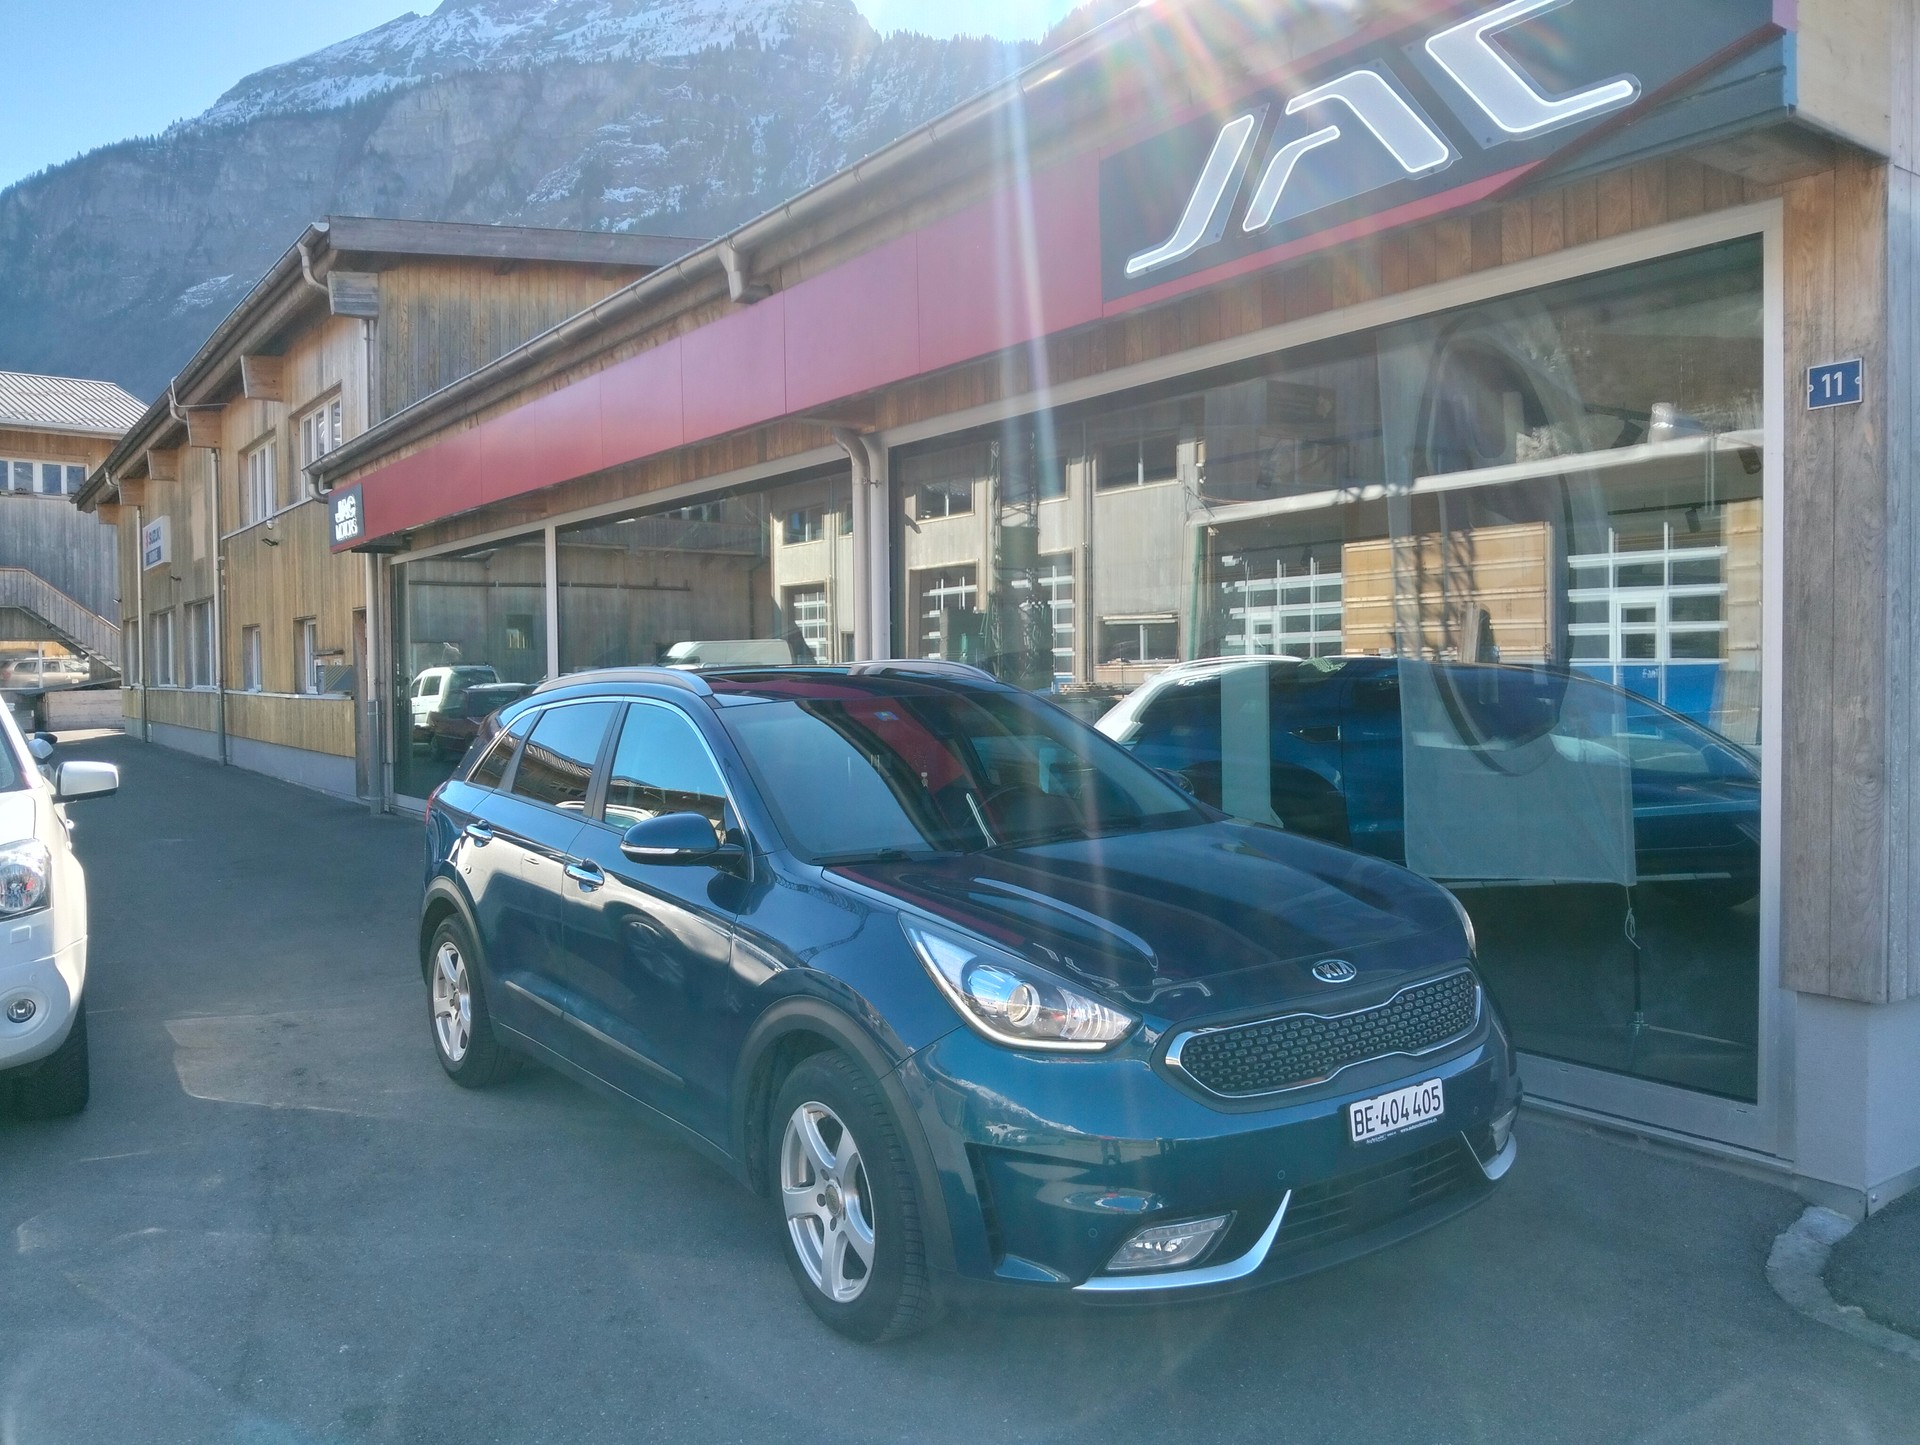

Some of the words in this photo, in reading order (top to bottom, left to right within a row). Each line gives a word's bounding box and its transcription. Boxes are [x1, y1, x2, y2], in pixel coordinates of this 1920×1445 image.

[1124, 0, 1638, 275] JAC
[1821, 371, 1843, 398] 11
[1318, 962, 1354, 979] KIA
